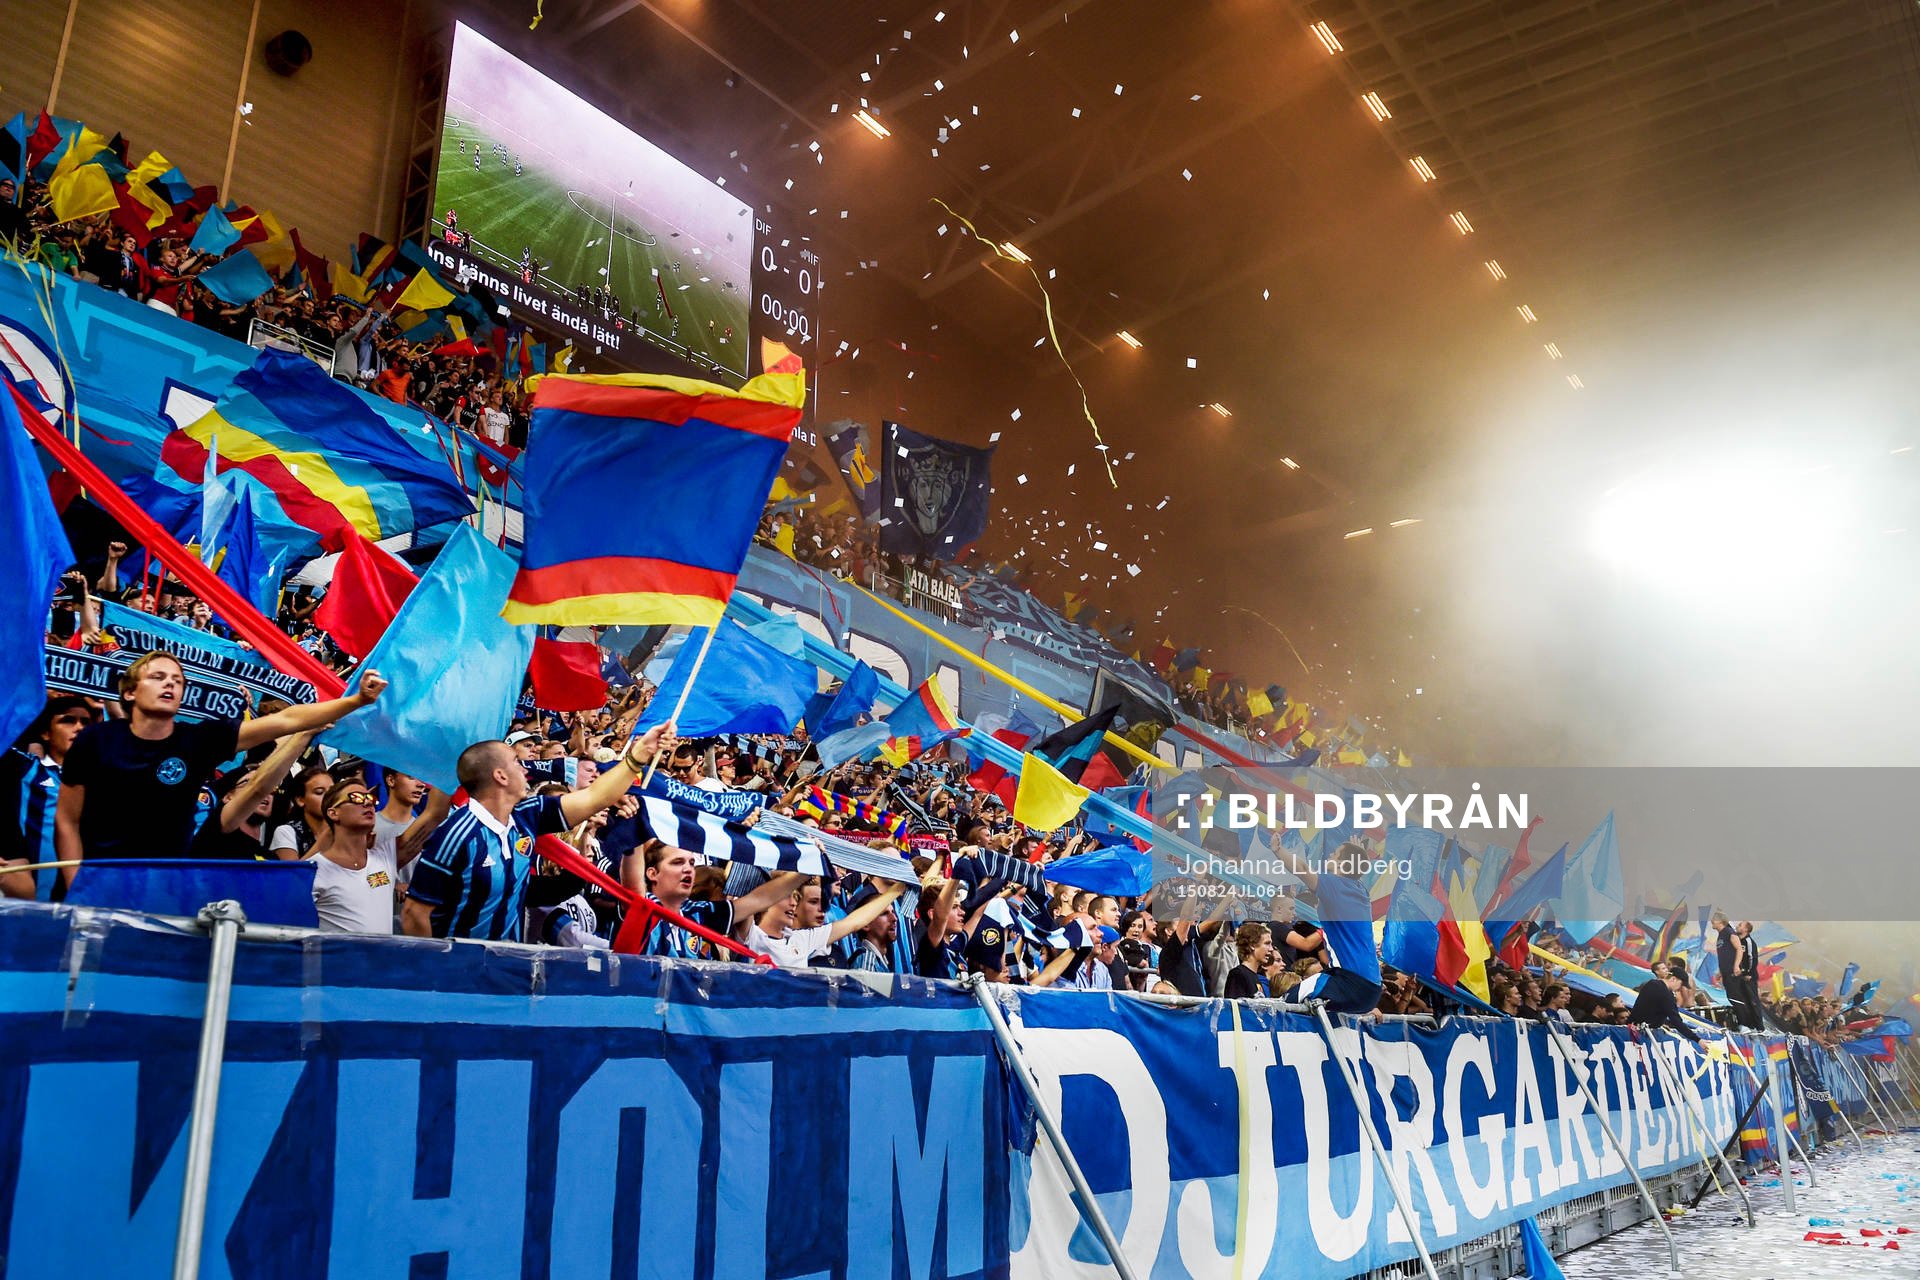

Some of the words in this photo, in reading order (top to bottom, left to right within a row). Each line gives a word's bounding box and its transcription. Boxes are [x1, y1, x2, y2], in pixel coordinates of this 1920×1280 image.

[756, 218, 772, 235] DIF
[762, 246, 774, 271] 0
[799, 269, 810, 294] 0
[458, 258, 509, 297] känns
[513, 285, 548, 315] livet
[551, 304, 589, 335] ändå
[592, 324, 620, 350] lätt!
[761, 294, 808, 335] 00:00
[113, 626, 223, 669] STOCKHOLM
[46, 654, 111, 688] HOLM
[205, 691, 243, 719] OSS
[1010, 1018, 1706, 1280] DJURGÅRDENS
